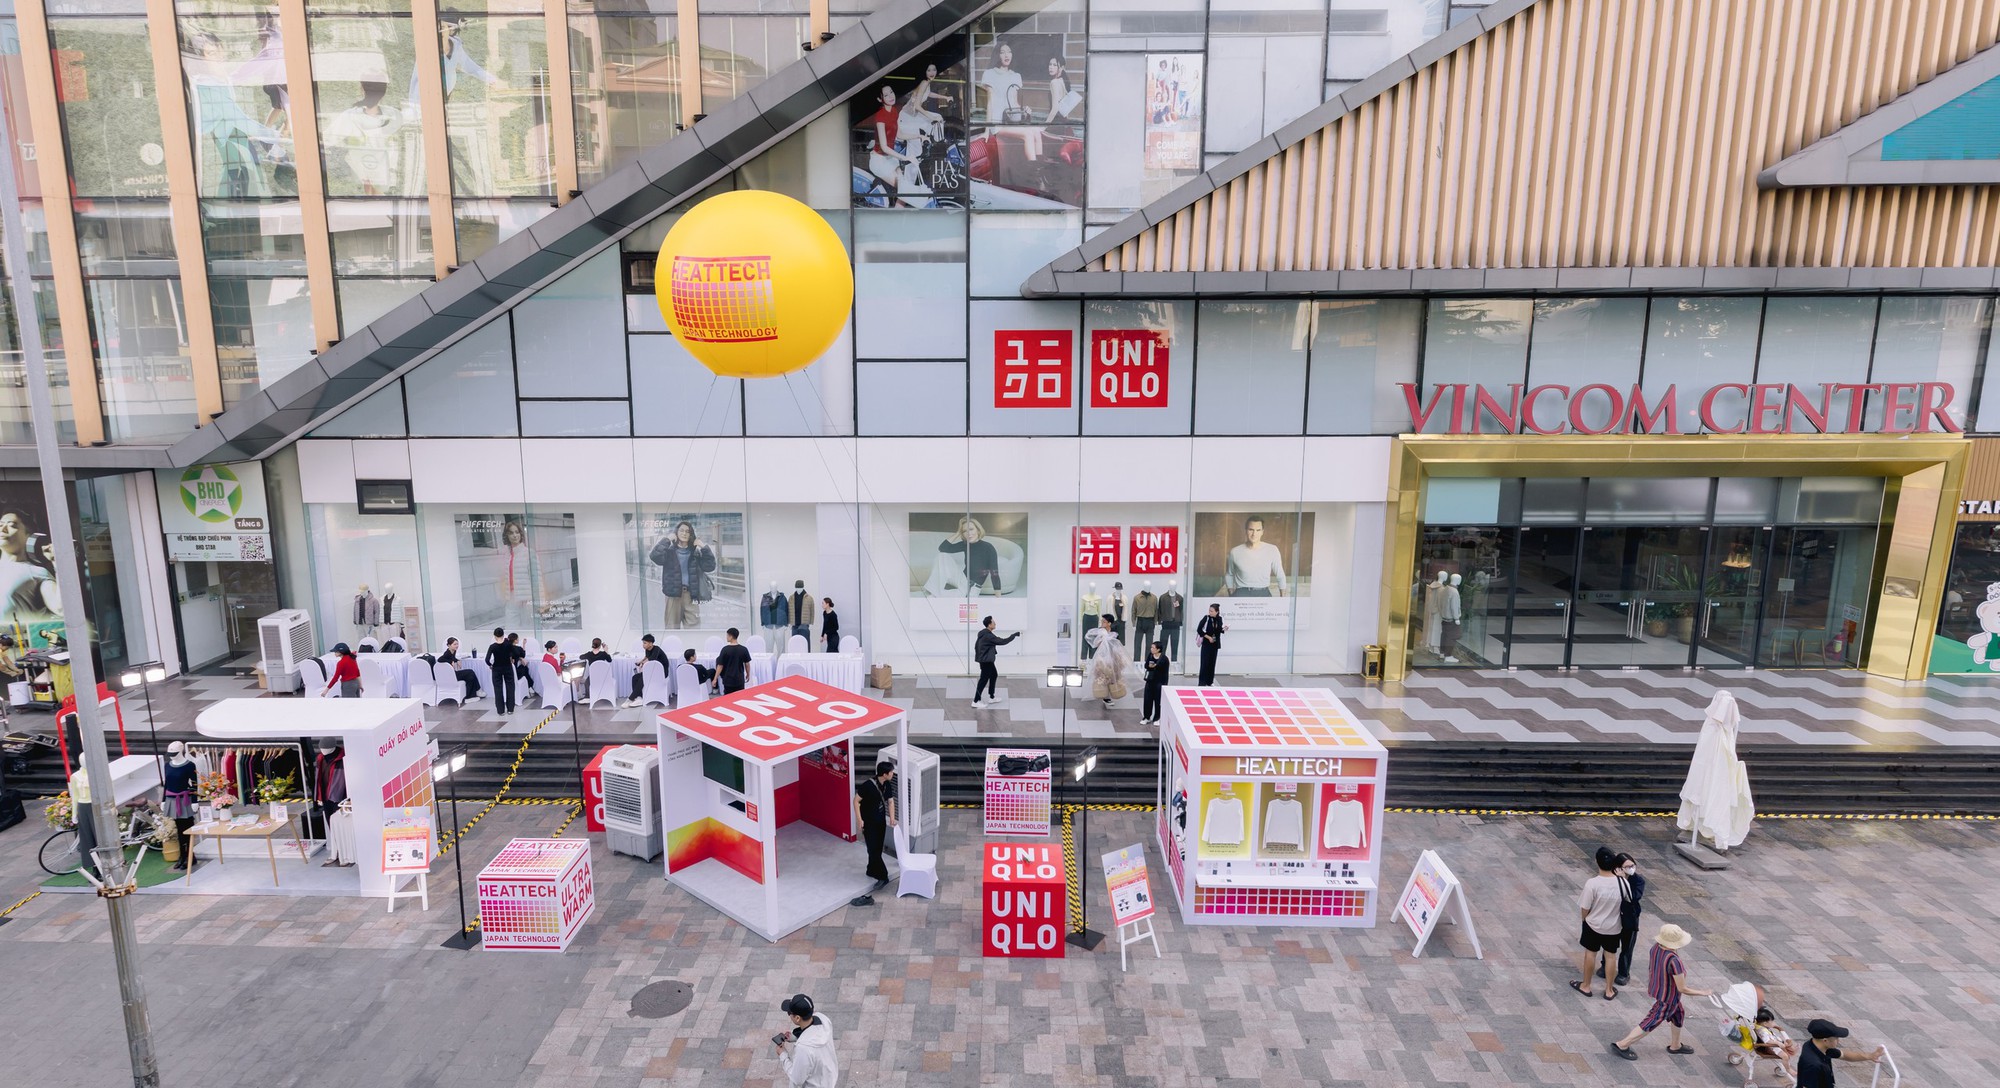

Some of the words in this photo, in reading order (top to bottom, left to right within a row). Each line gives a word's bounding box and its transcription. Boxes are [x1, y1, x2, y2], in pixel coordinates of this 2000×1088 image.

[934, 160, 956, 176] HA
[932, 174, 959, 188] PAS
[672, 261, 770, 282] HEATTECH
[682, 328, 706, 338] JAPAN
[709, 327, 778, 338] TECHNOLOGY
[1005, 340, 1061, 366] ユニ
[1100, 340, 1154, 366] UNI
[1002, 373, 1062, 398] クロ
[1100, 372, 1160, 403] QLO
[1396, 382, 1680, 435] VINCOM
[1701, 382, 1963, 434] CENTER
[196, 481, 225, 500] BHD
[1079, 533, 1114, 548] ユニ
[1136, 532, 1170, 549] UNI
[1135, 552, 1172, 571] QLO
[688, 686, 820, 728] UNI
[739, 700, 869, 746] QLO
[1235, 757, 1342, 776] HEATTECH
[986, 781, 1050, 792] HEATTECH
[992, 847, 1048, 862] UNI
[992, 863, 1056, 880] QLO
[479, 884, 557, 897] HEATTECH
[561, 862, 590, 907] ULTRA
[562, 878, 592, 927] WARM
[991, 890, 1051, 918] UNI
[991, 923, 1057, 954] QLO
